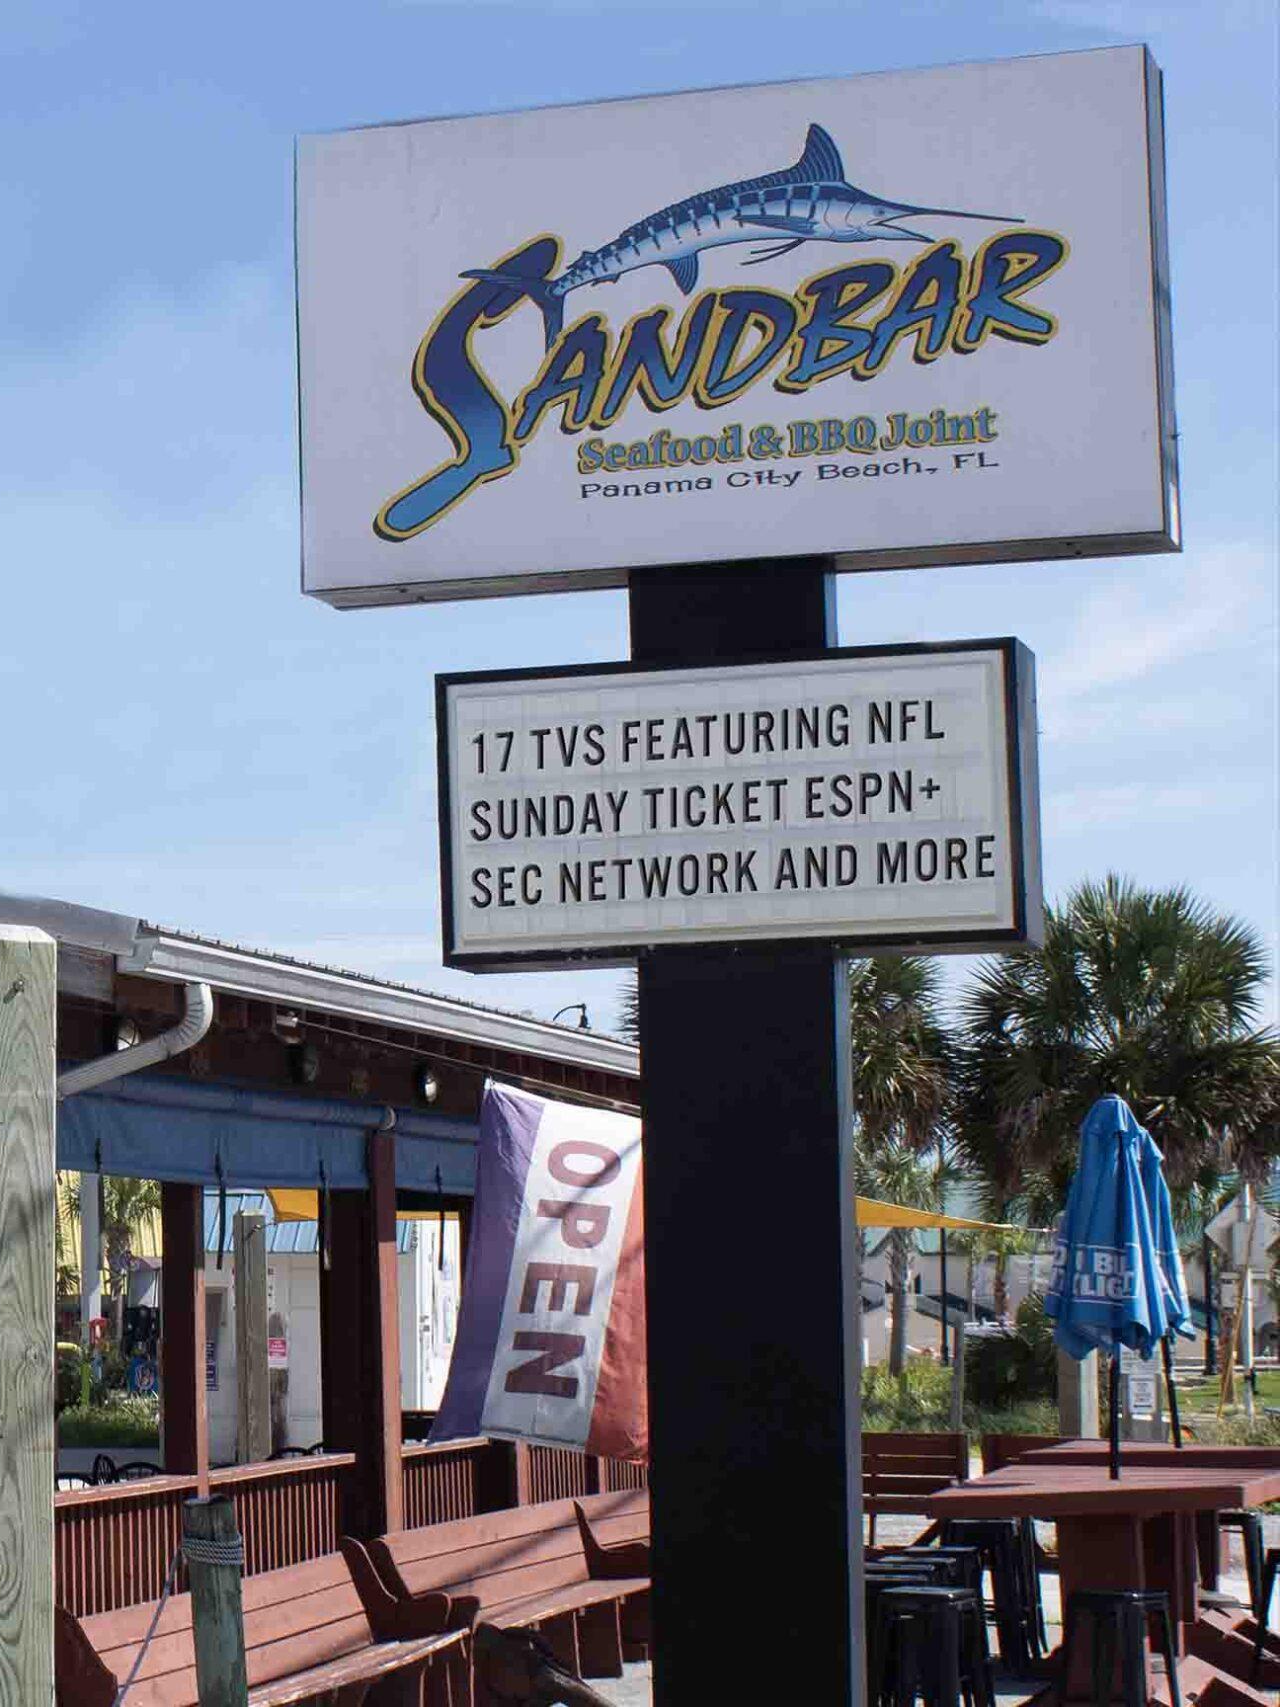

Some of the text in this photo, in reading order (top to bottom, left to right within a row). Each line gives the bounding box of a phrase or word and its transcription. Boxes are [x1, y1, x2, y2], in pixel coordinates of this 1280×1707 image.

[373, 229, 1070, 542] SANDBAR
[578, 406, 998, 474] Seafood & BBQ Joint
[581, 452, 999, 499] Panama City Beach, FL
[471, 699, 945, 774] 17 TVS FEATURING NFL
[470, 769, 941, 841] SUNDAY TICKET ESPN+
[470, 835, 996, 909] SEC NETWORK AND MORE
[504, 1140, 620, 1399] OPEN
